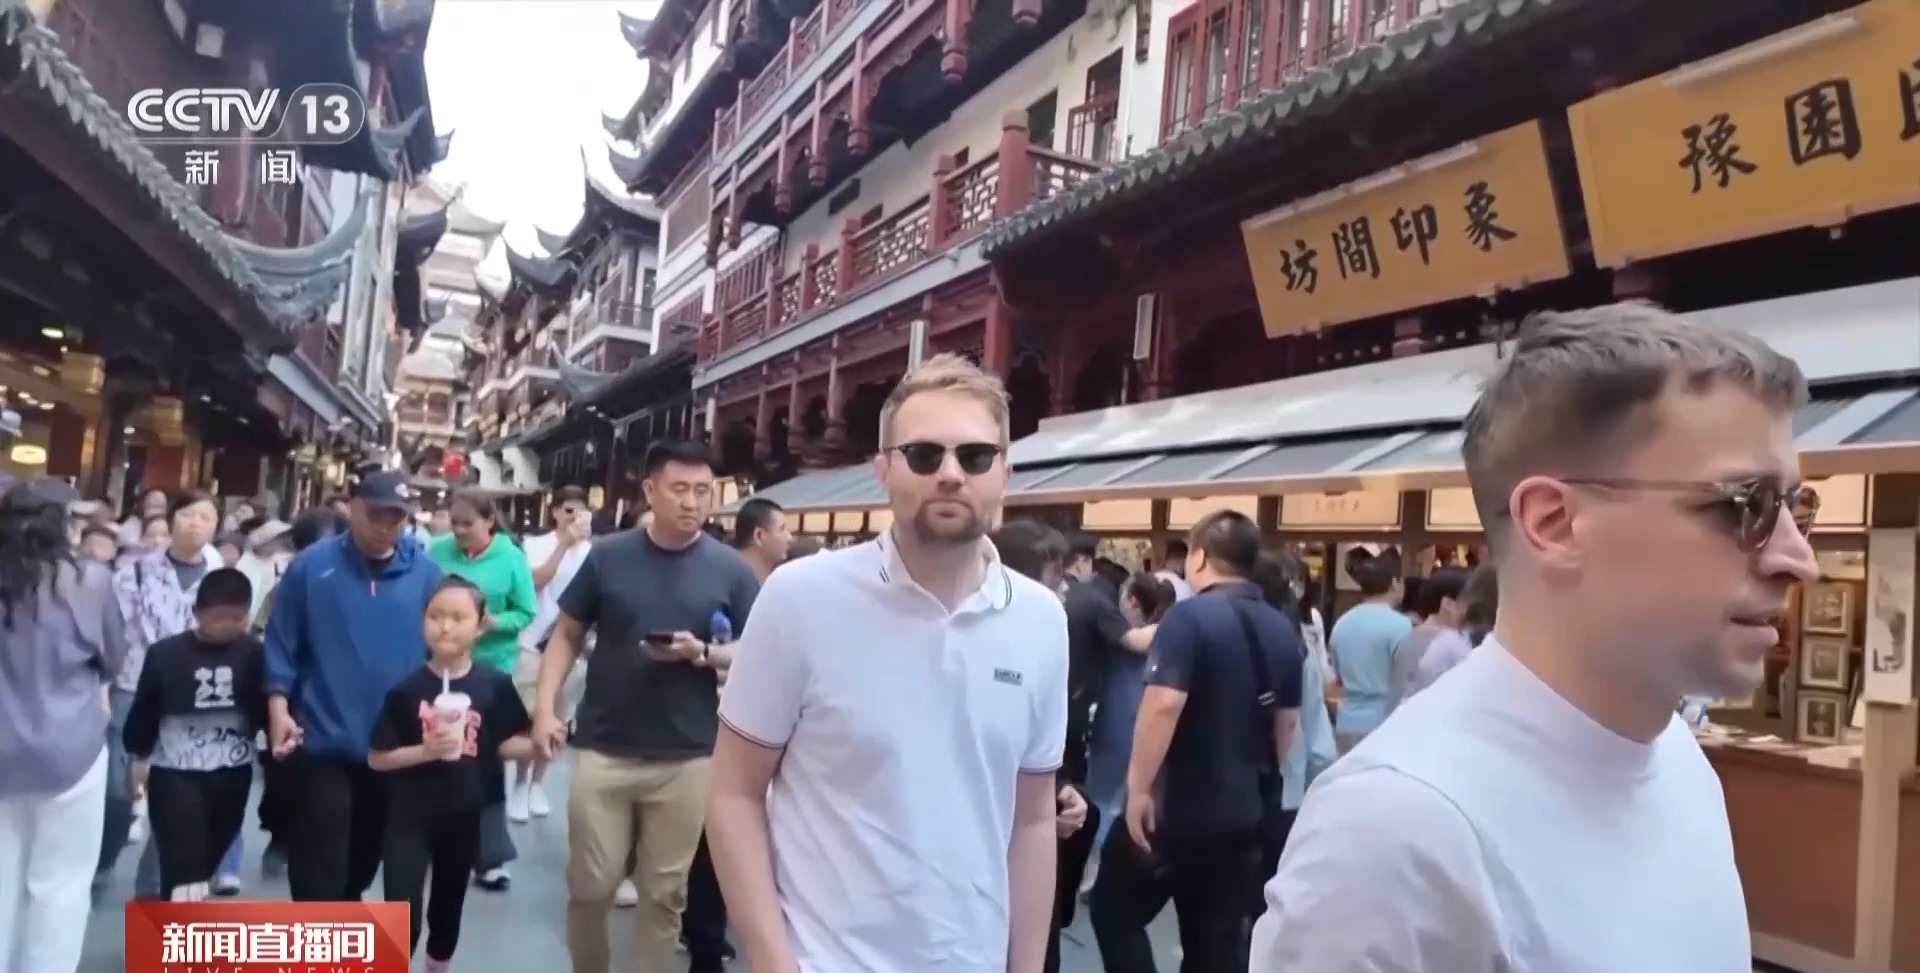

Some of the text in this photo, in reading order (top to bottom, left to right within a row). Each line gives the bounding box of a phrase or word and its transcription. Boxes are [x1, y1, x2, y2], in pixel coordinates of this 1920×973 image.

[1678, 57, 1920, 194] 豫園
[1280, 181, 1517, 295] 坊間印象
